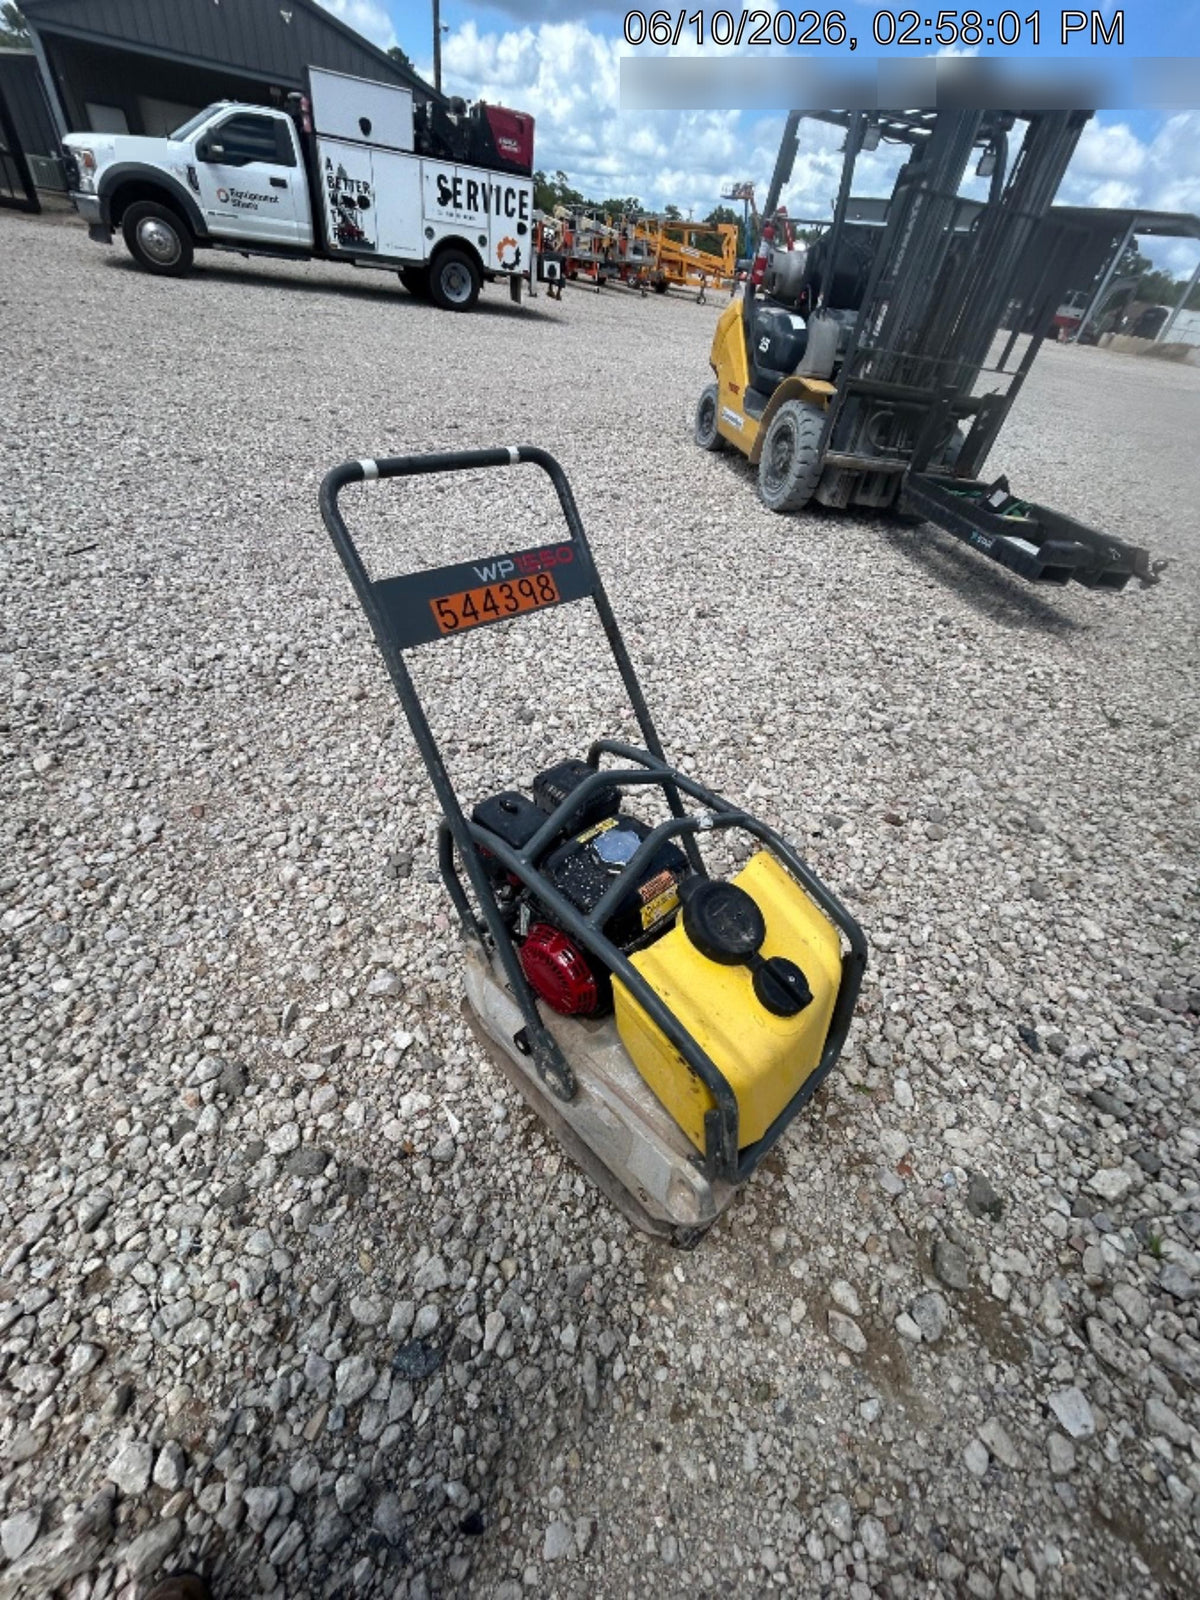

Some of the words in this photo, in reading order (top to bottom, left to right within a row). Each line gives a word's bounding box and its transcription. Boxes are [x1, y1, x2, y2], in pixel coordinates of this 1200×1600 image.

[326, 175, 371, 195] BETTER
[436, 173, 529, 221] SERVICE
[473, 546, 574, 583] WP1550
[435, 572, 557, 630] 544398
